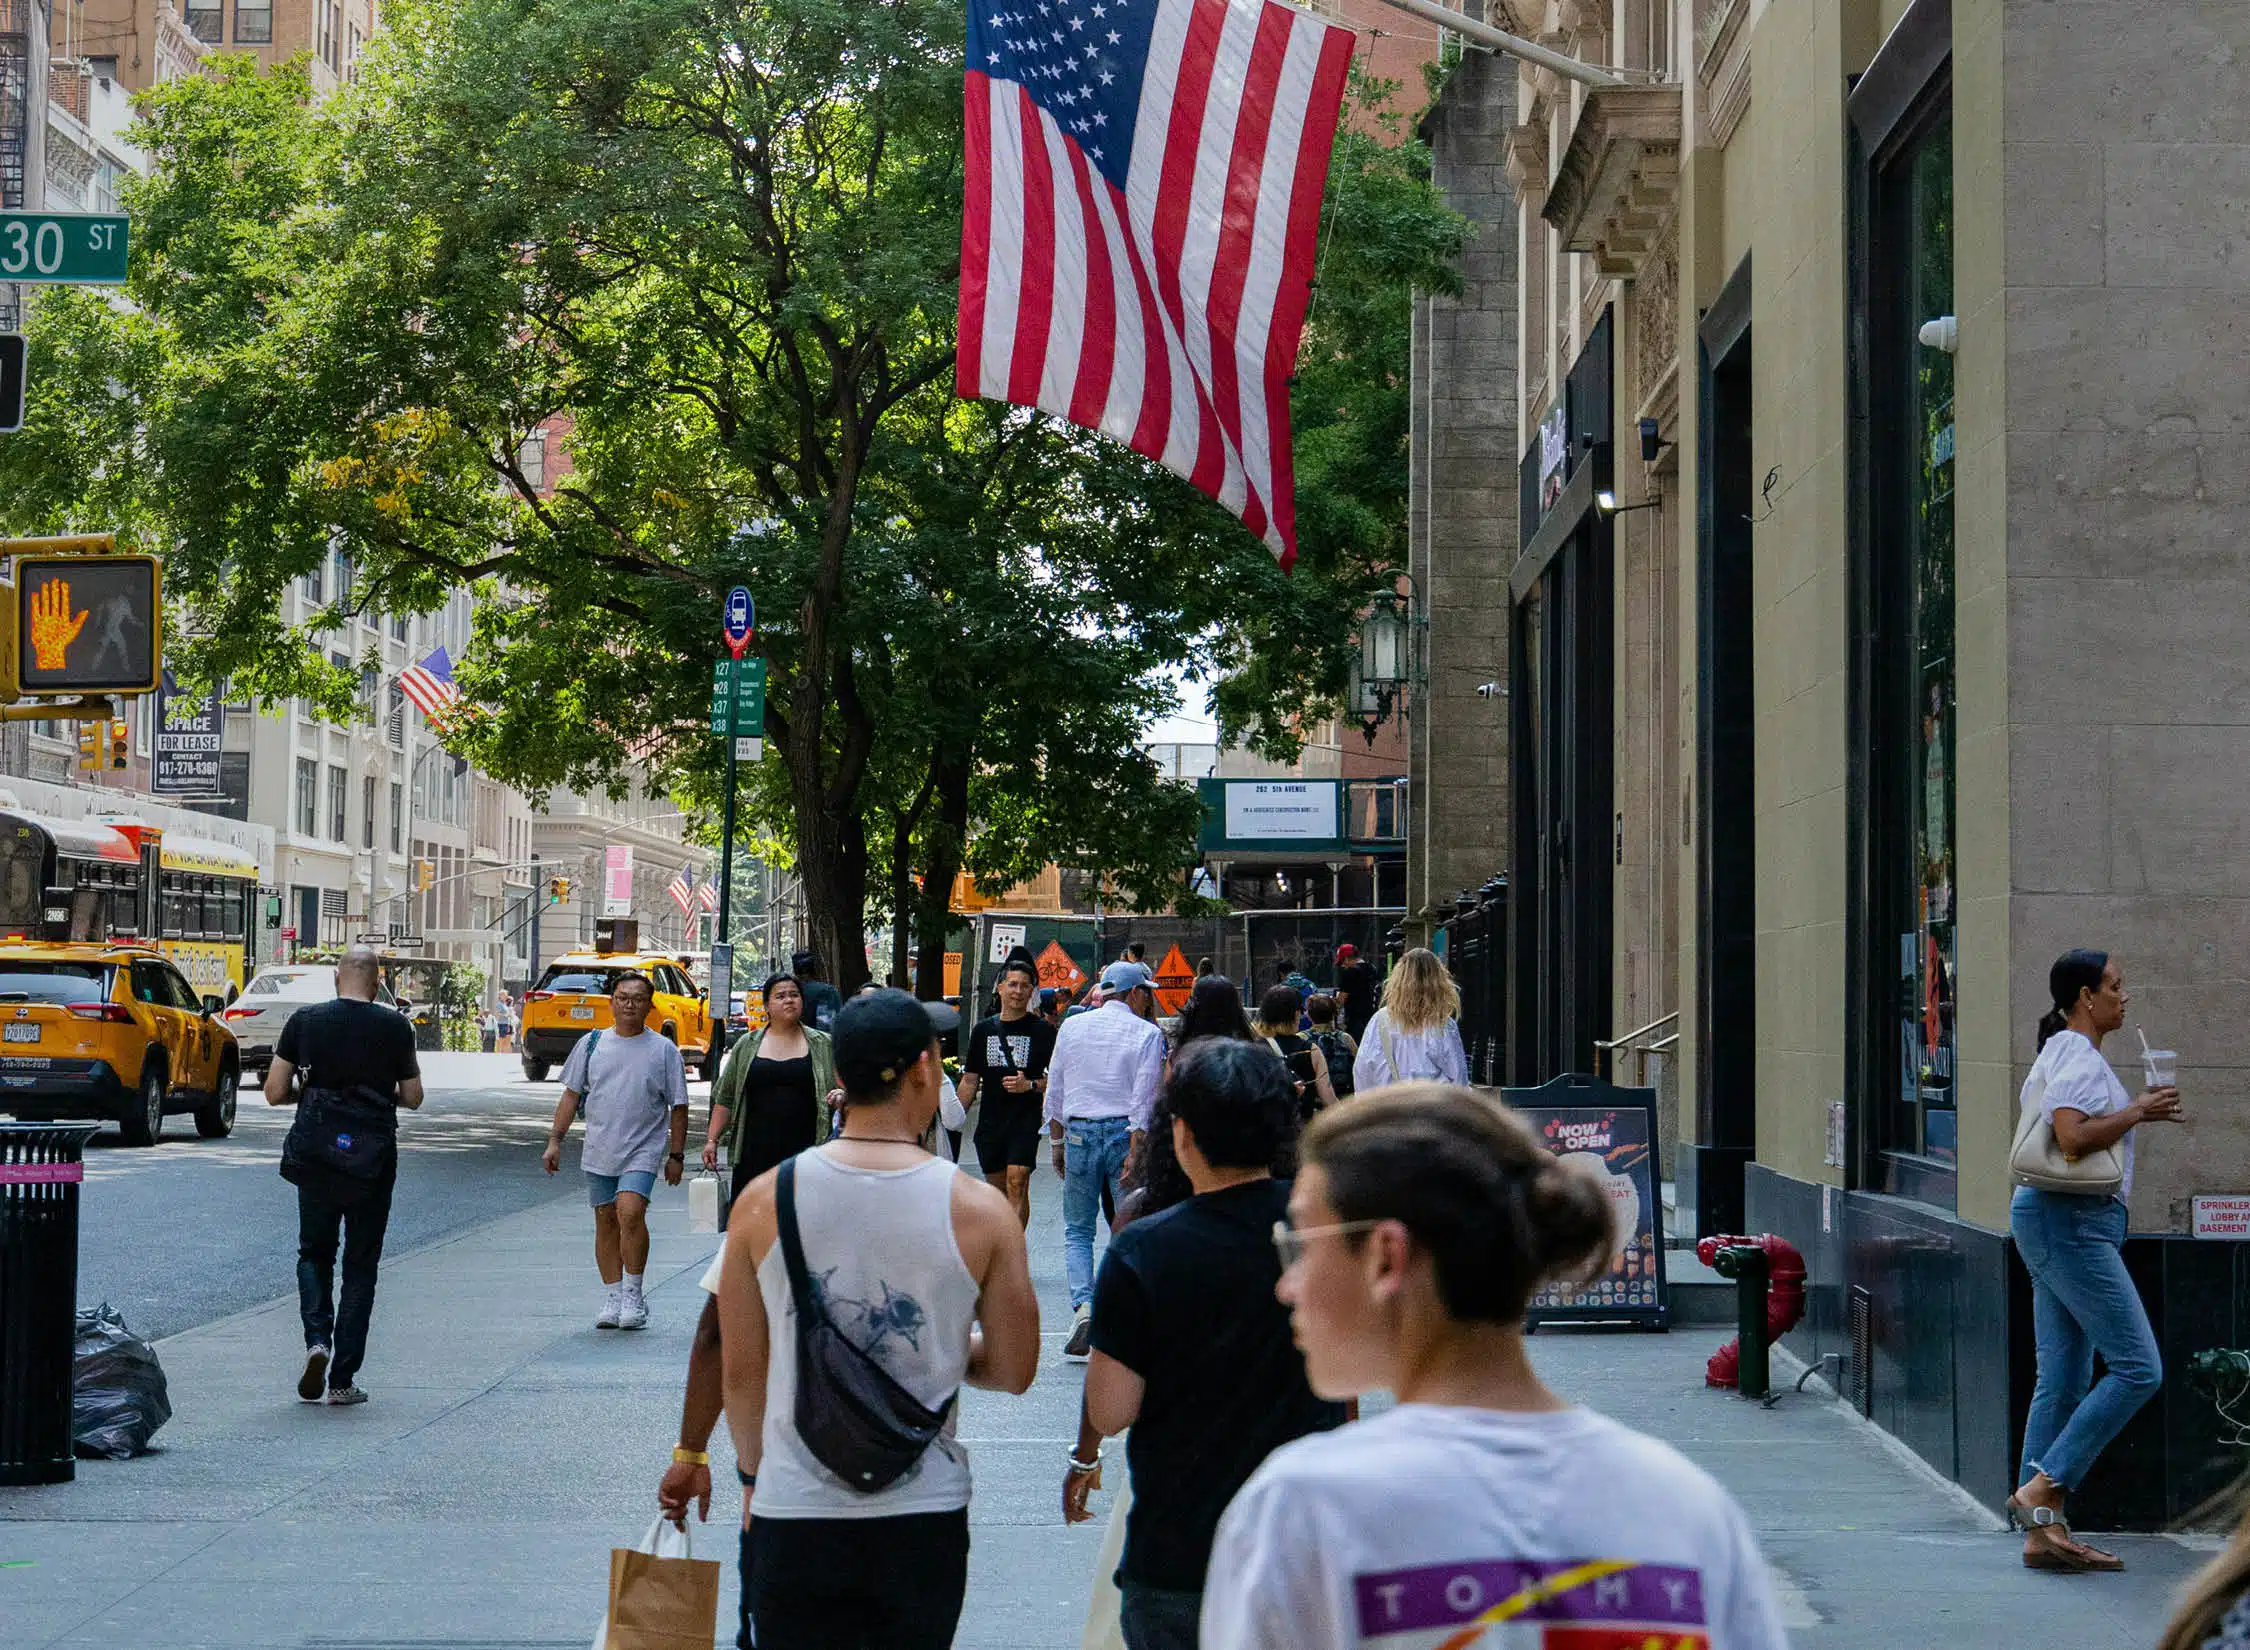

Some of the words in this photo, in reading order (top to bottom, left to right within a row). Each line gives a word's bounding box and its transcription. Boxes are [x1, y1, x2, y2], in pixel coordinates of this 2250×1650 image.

[1, 221, 64, 274] 30
[88, 224, 117, 251] ST
[161, 736, 178, 750] FOR
[182, 736, 217, 750] LEASE
[1284, 785, 1307, 793] AVENUE
[944, 954, 961, 965] OSED
[1558, 1123, 1600, 1138] NOW
[1565, 1134, 1611, 1149] OPEN
[2200, 1201, 2249, 1210] SPRINKLER
[2210, 1212, 2239, 1221] LOBBY
[2200, 1223, 2247, 1232] BASEMENT
